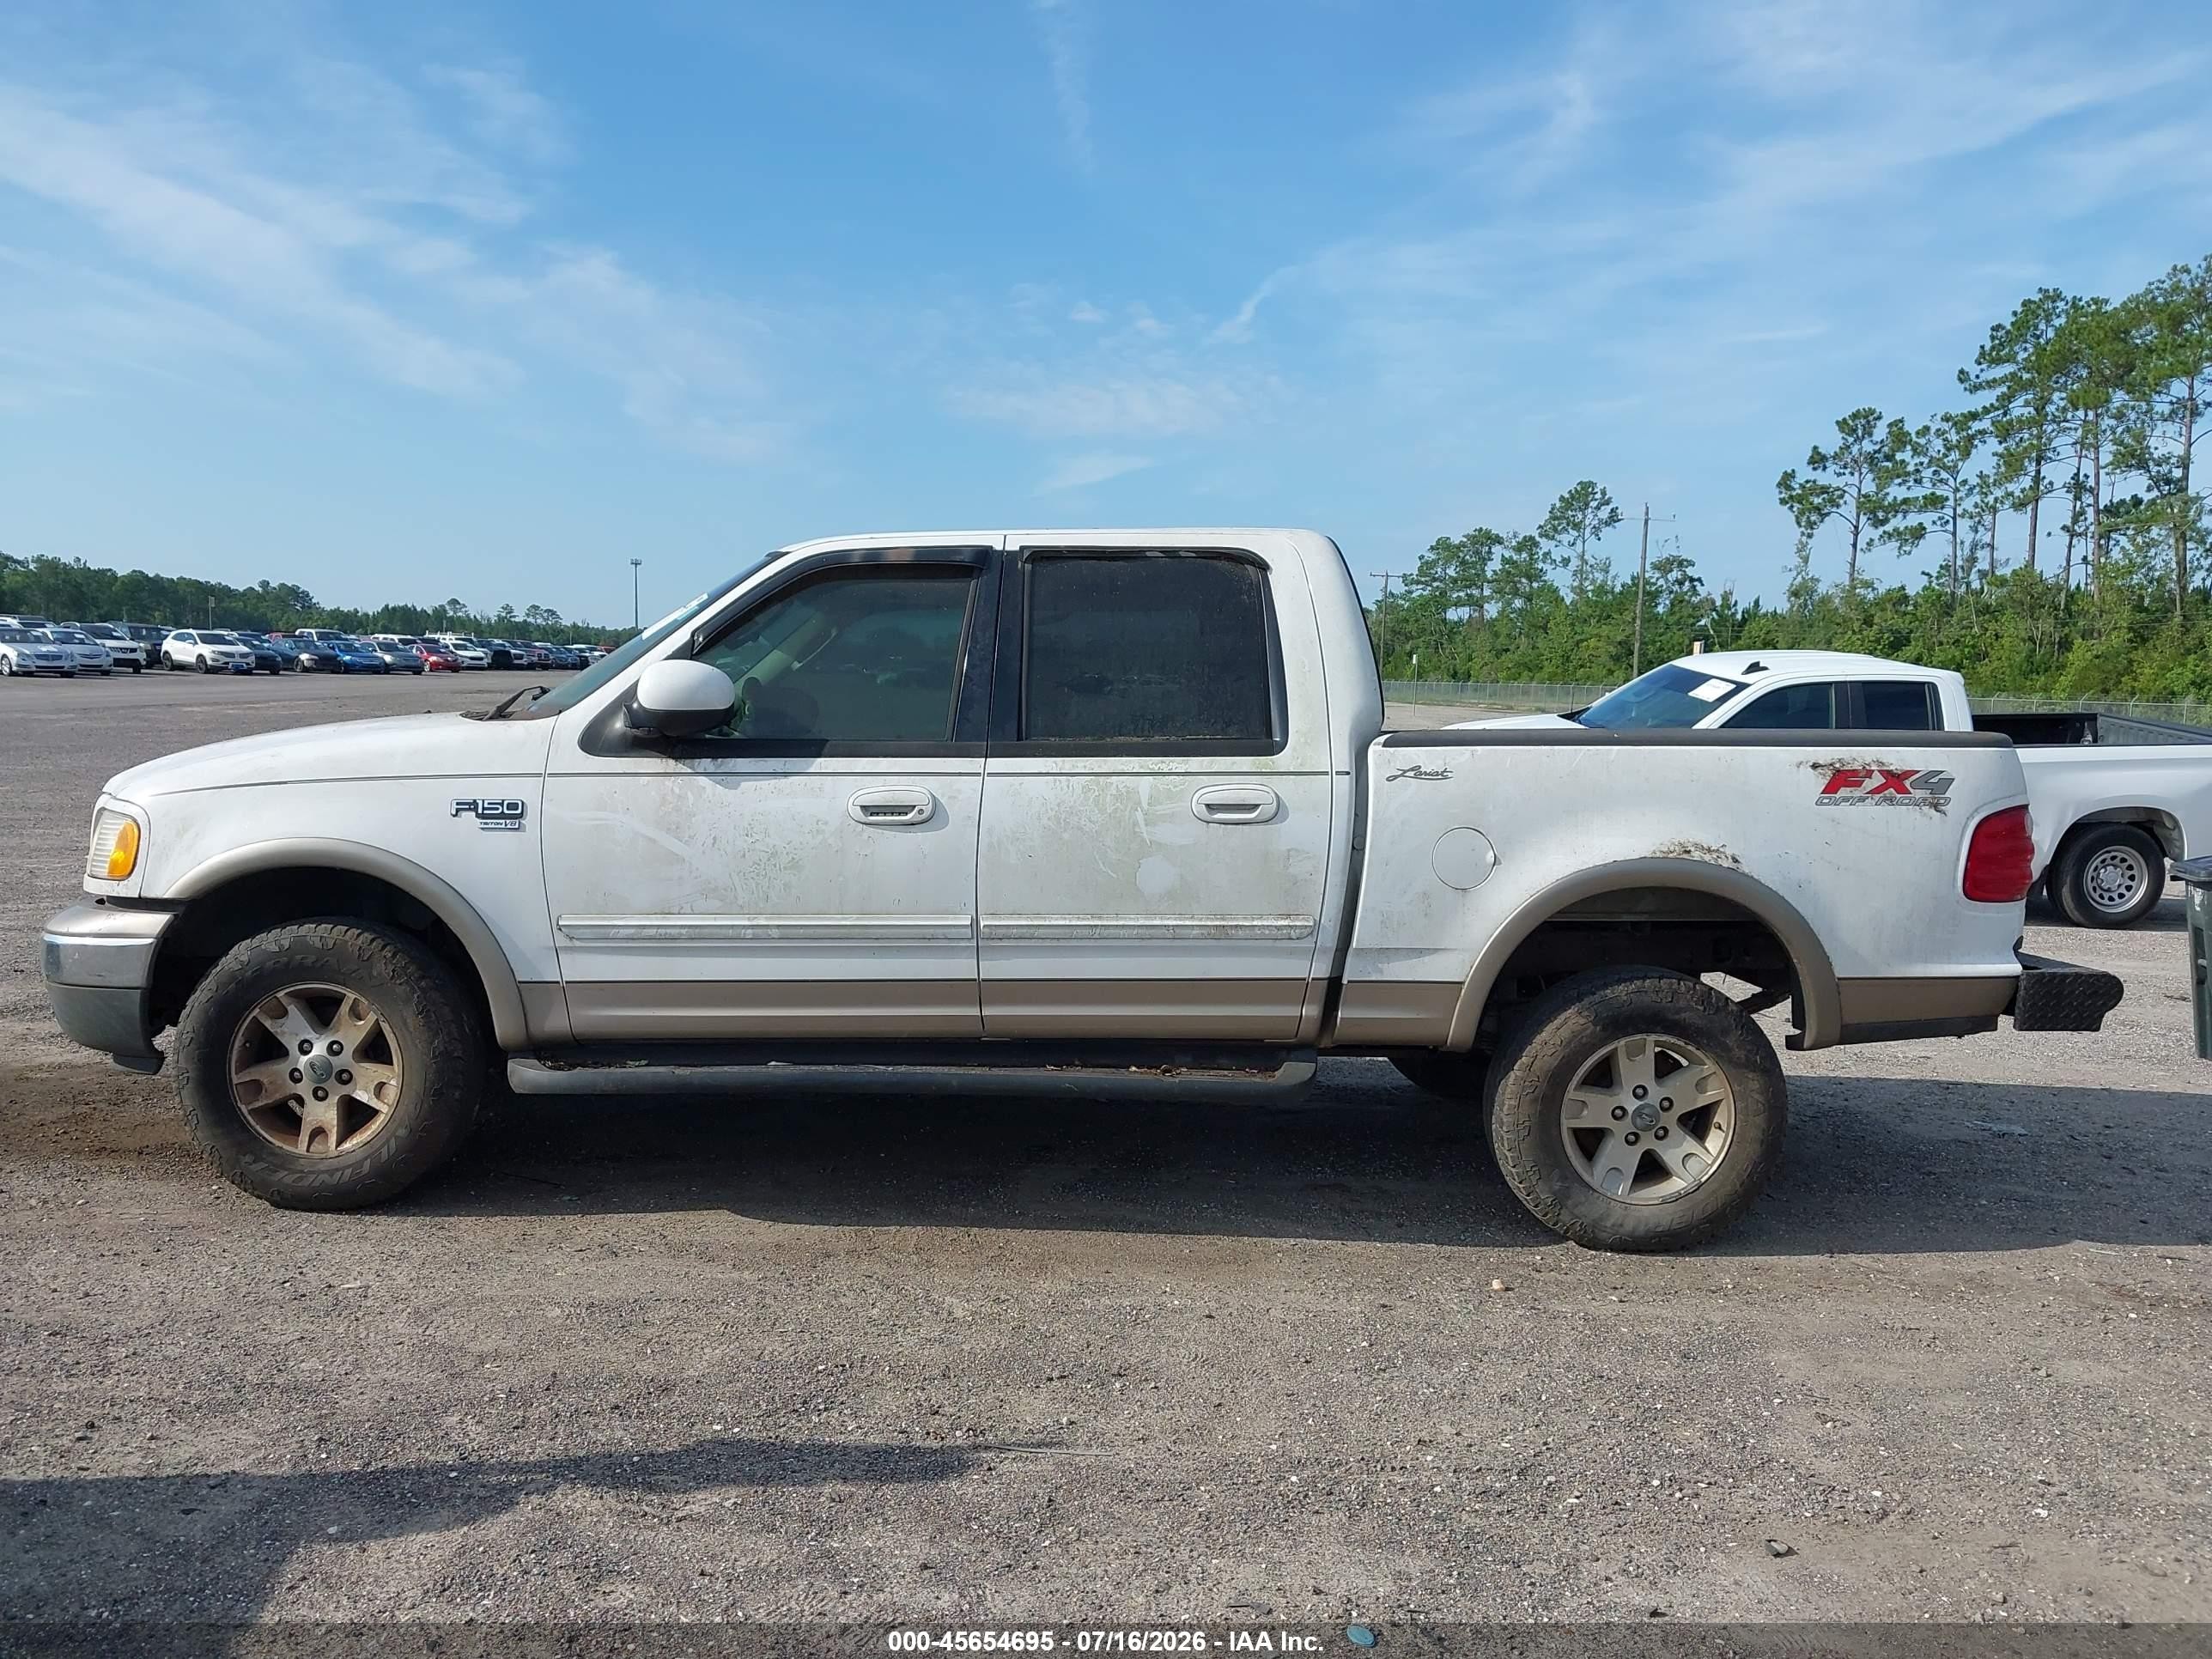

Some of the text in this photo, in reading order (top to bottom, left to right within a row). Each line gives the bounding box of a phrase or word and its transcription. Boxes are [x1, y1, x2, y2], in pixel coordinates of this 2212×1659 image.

[1385, 764, 1455, 782] Lariat
[1820, 769, 1956, 795] FX4
[1814, 795, 1952, 807] OFF ROAD
